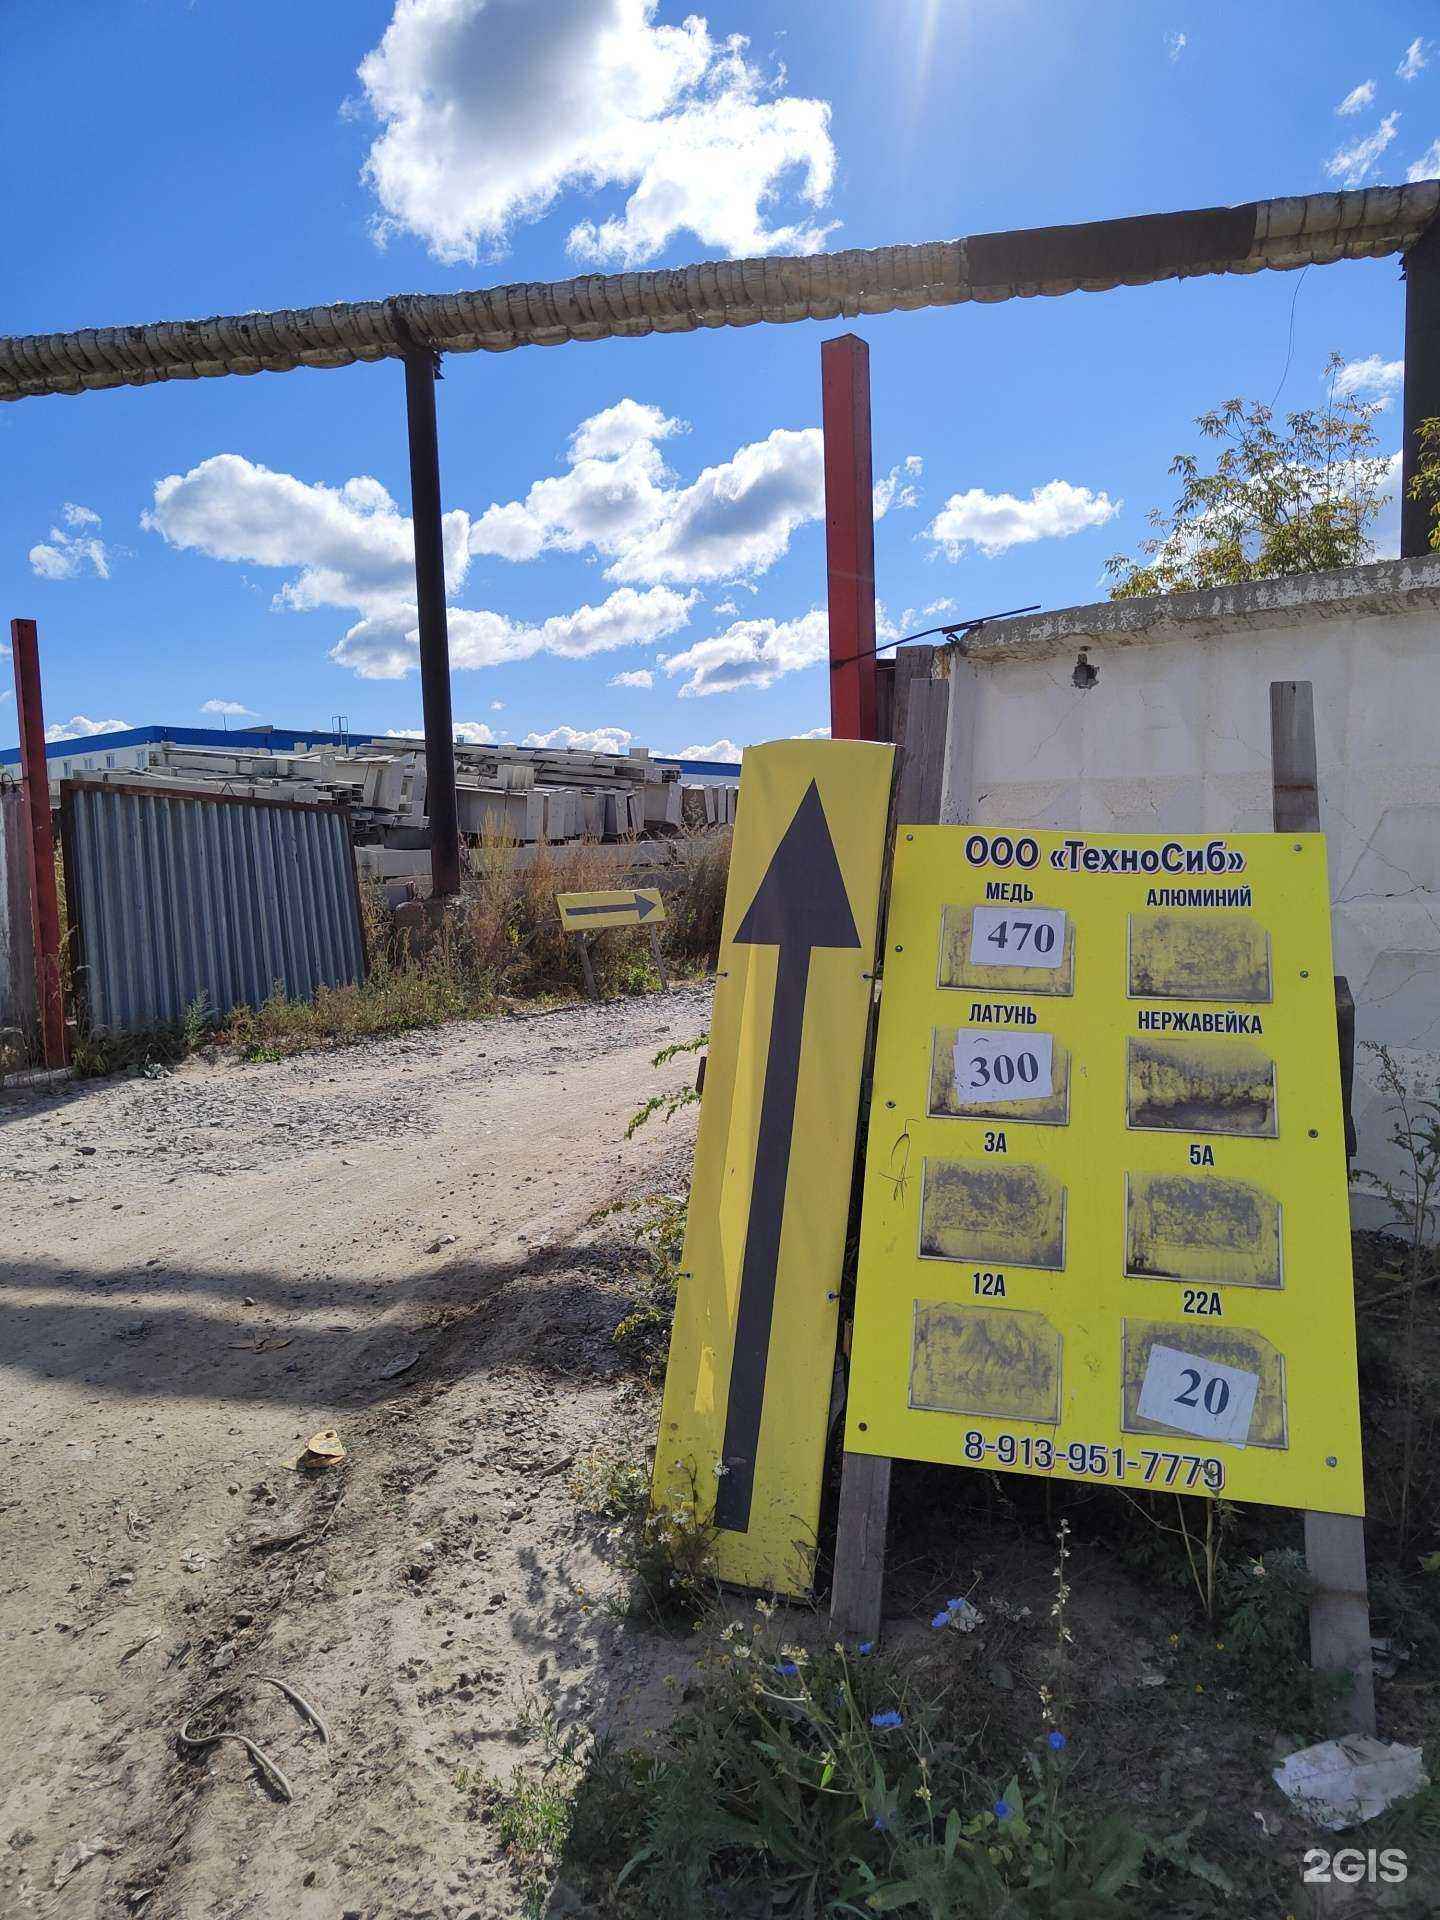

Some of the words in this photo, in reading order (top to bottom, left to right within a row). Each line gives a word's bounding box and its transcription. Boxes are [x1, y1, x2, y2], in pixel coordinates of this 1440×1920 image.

[965, 835, 1039, 869] ООО
[1050, 839, 1247, 873] «ТехноСиб»
[985, 882, 1034, 903] МЕДЬ
[1146, 884, 1252, 908] АЛЮМИНИЙ
[987, 921, 1055, 953] 470
[968, 1003, 1038, 1026] ЛАТУНЬ
[1137, 1009, 1263, 1035] НЕРЖАВЕЙКА
[970, 1052, 1039, 1088] 300
[1189, 1145, 1215, 1167] 5А
[972, 1273, 1006, 1297] 12А
[1183, 1291, 1222, 1316] 22А
[1173, 1368, 1230, 1415] 20
[964, 1431, 1225, 1490] 8-913-951-7779
